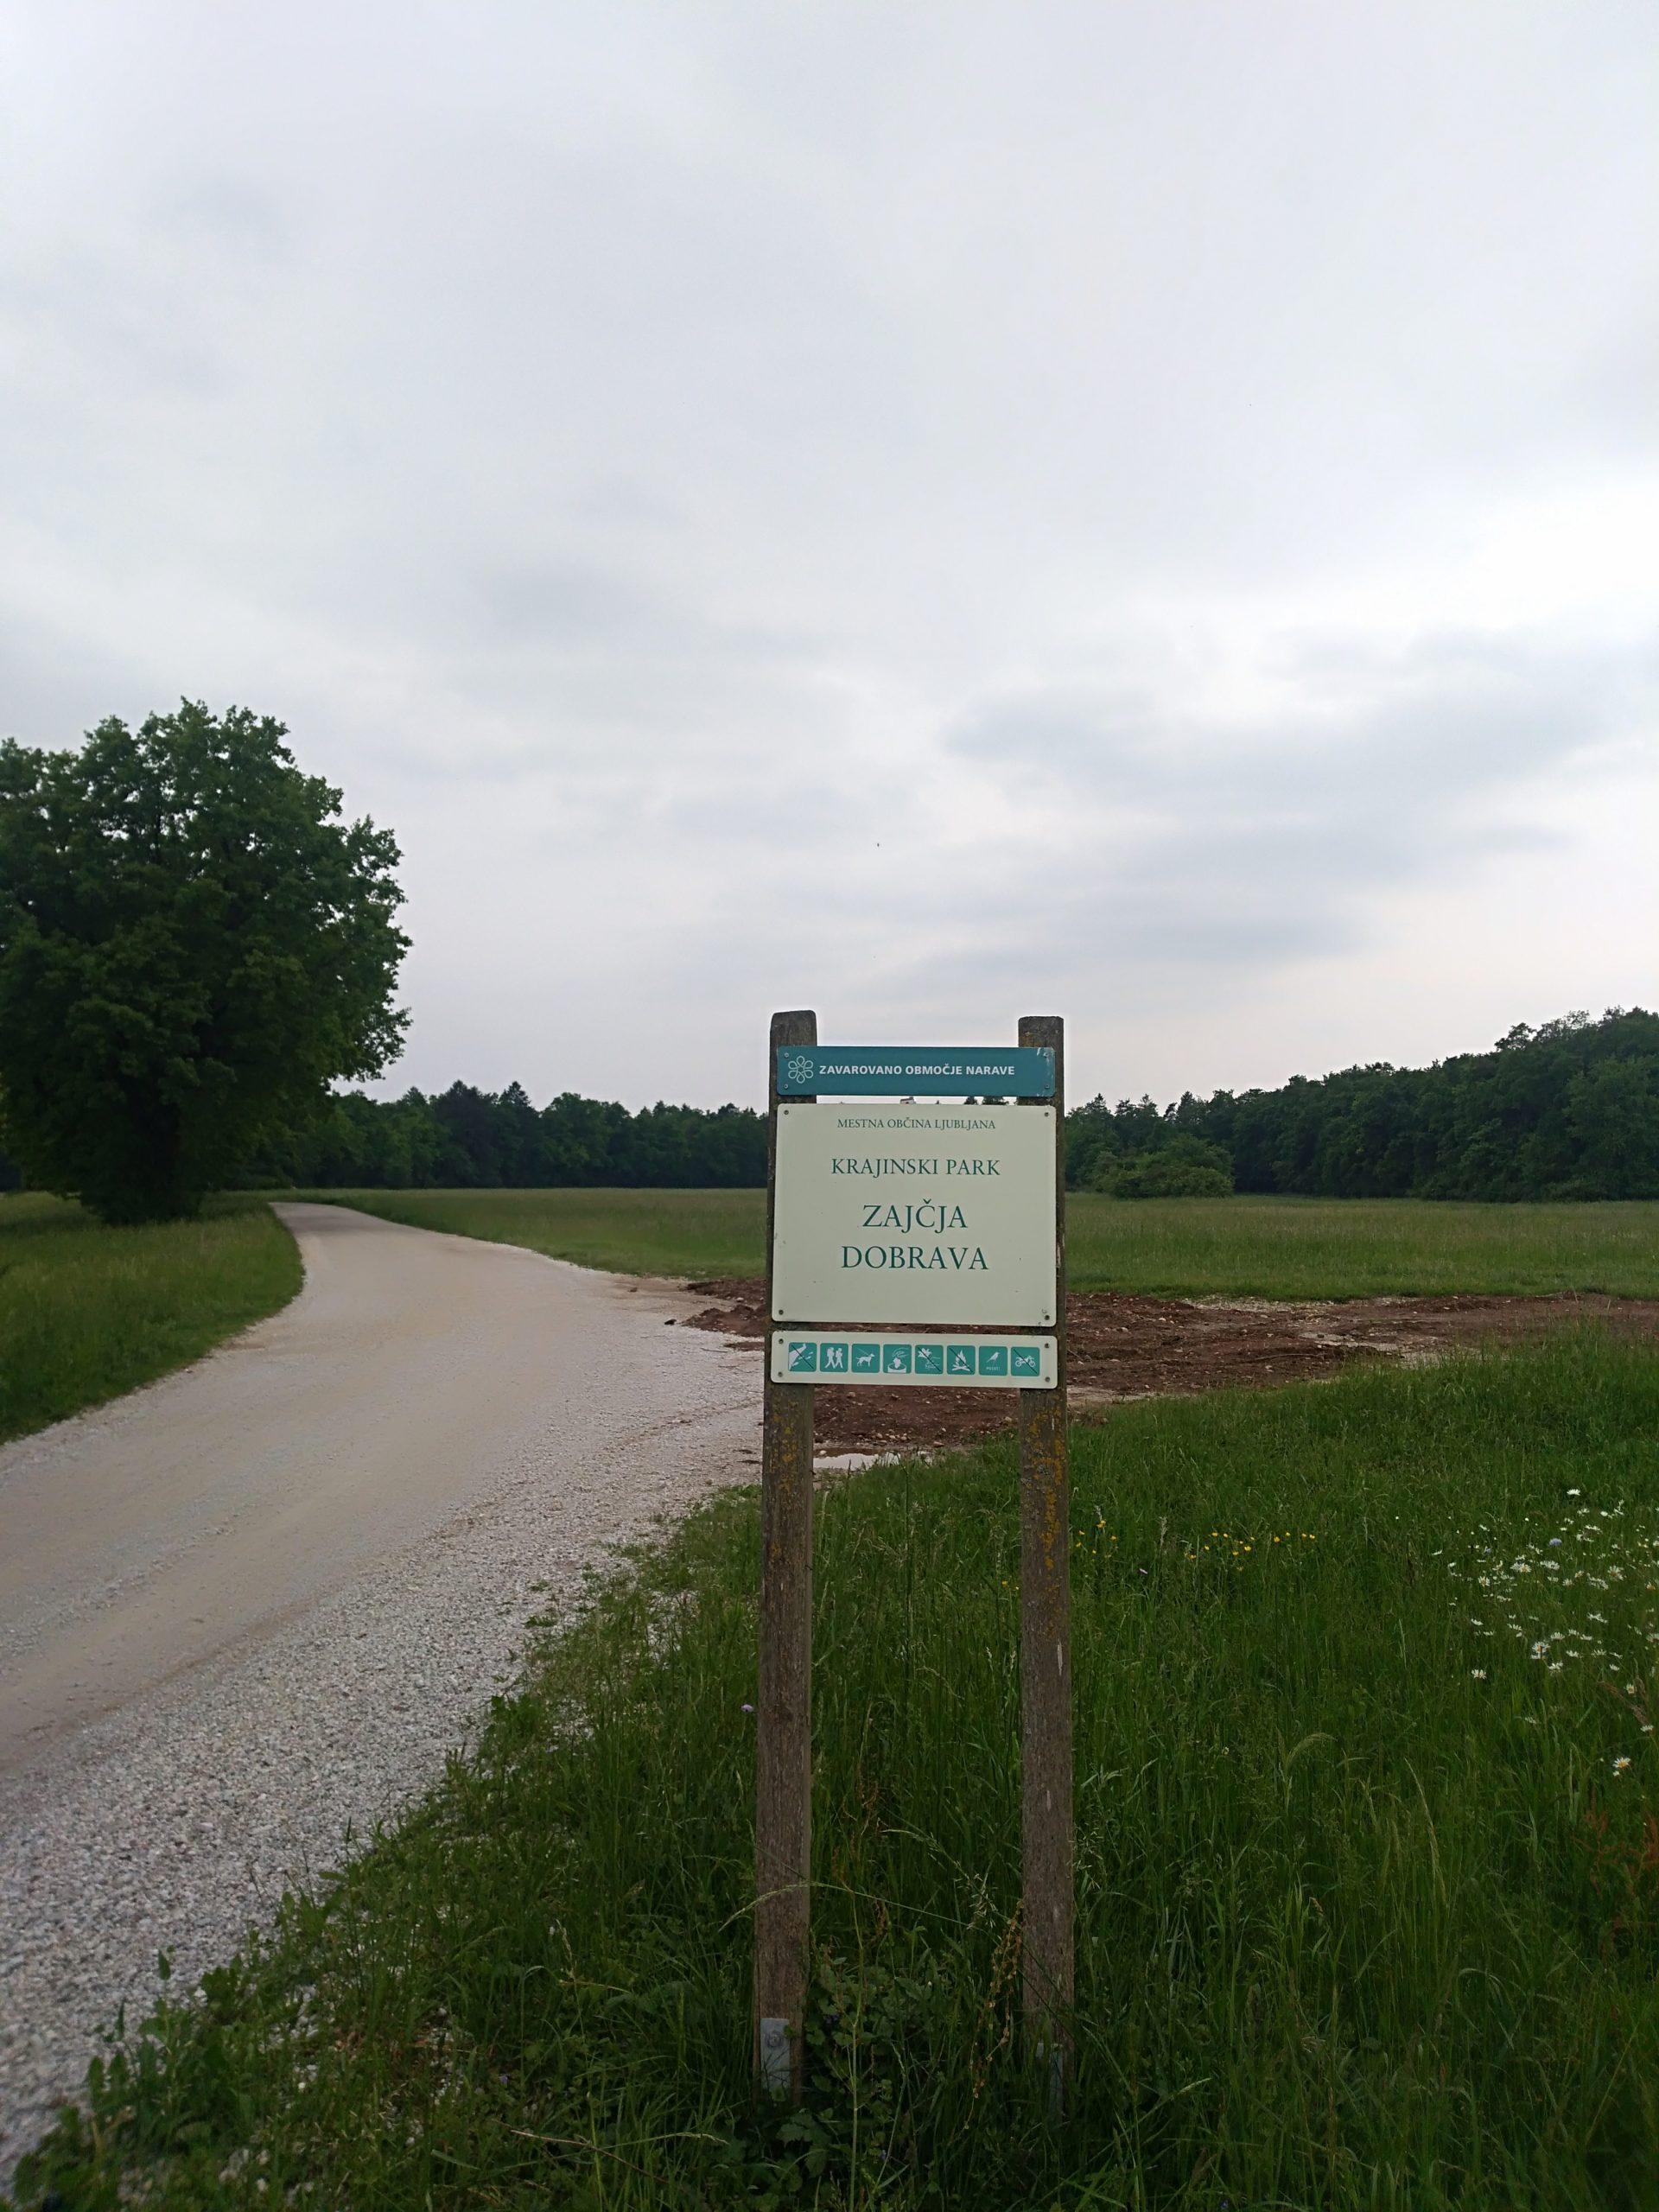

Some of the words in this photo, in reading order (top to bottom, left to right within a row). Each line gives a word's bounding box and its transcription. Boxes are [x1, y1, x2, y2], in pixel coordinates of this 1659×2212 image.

[819, 1065, 902, 1076] ZAVAROVANO
[906, 1064, 963, 1076] OBMOČJE
[966, 1065, 1015, 1076] NARAVE
[837, 1119, 885, 1129] MESTNA
[887, 1116, 931, 1129] OBČINA
[935, 1120, 995, 1131] LJUBLJANA
[831, 1159, 938, 1178] KRAJINSKI
[946, 1160, 1001, 1176] PARK
[862, 1198, 968, 1233] ZAJČJA
[842, 1245, 988, 1269] DOBRAVA
